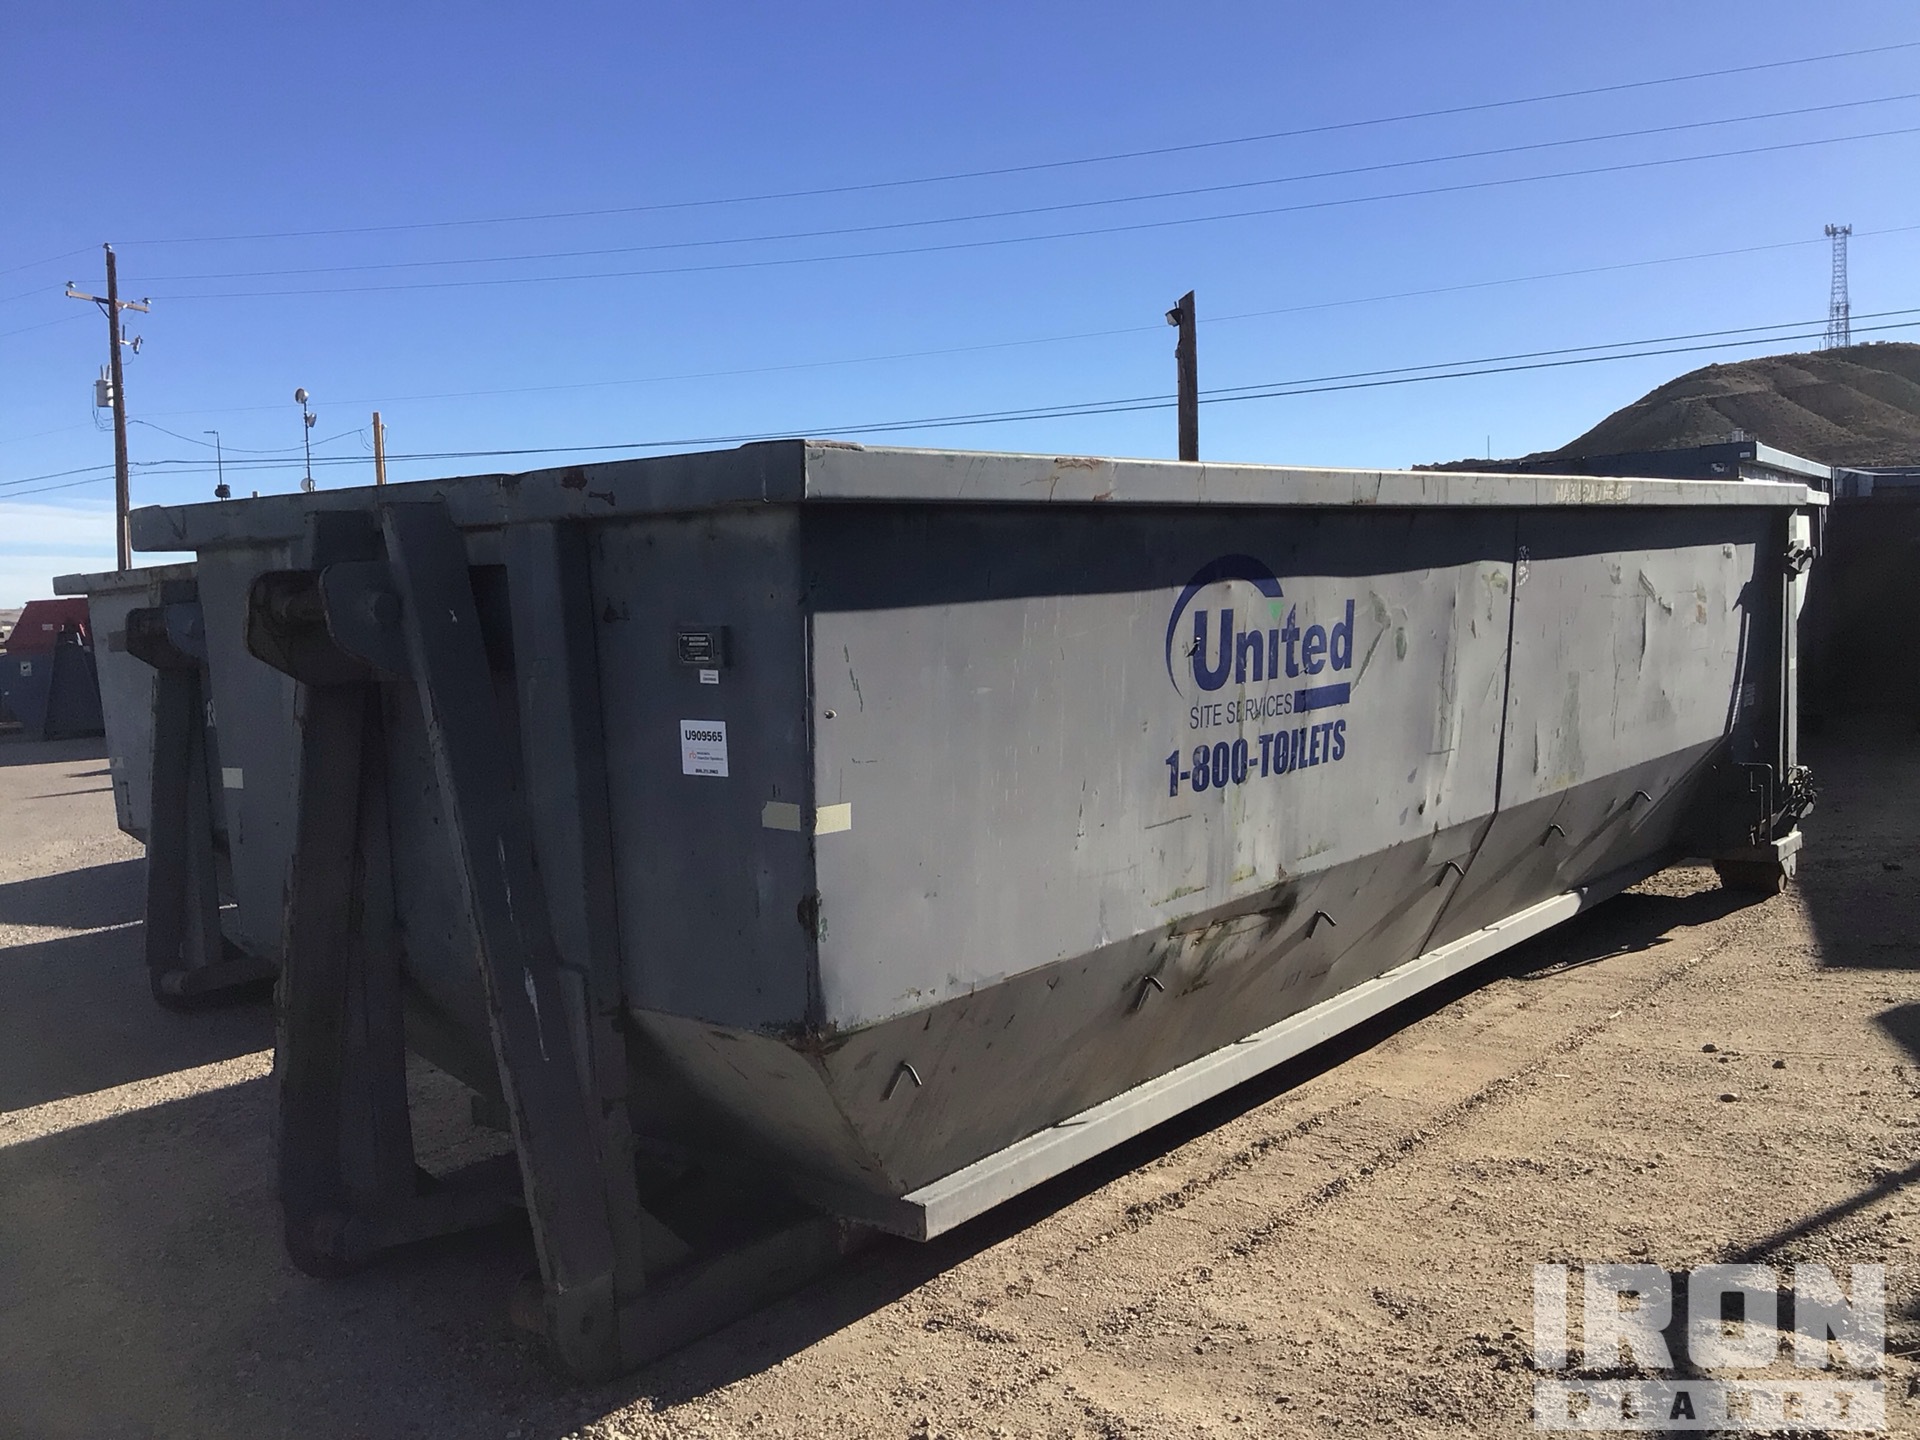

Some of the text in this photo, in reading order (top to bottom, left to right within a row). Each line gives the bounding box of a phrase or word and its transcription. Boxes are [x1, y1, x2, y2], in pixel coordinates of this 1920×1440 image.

[1555, 483, 1577, 502] MAX
[1603, 484, 1632, 501] HEGHT
[1193, 599, 1355, 691] United
[1189, 693, 1293, 729] SITE SERVICES
[685, 730, 723, 742] U909565
[1166, 719, 1346, 797] 1-800-TOILETS
